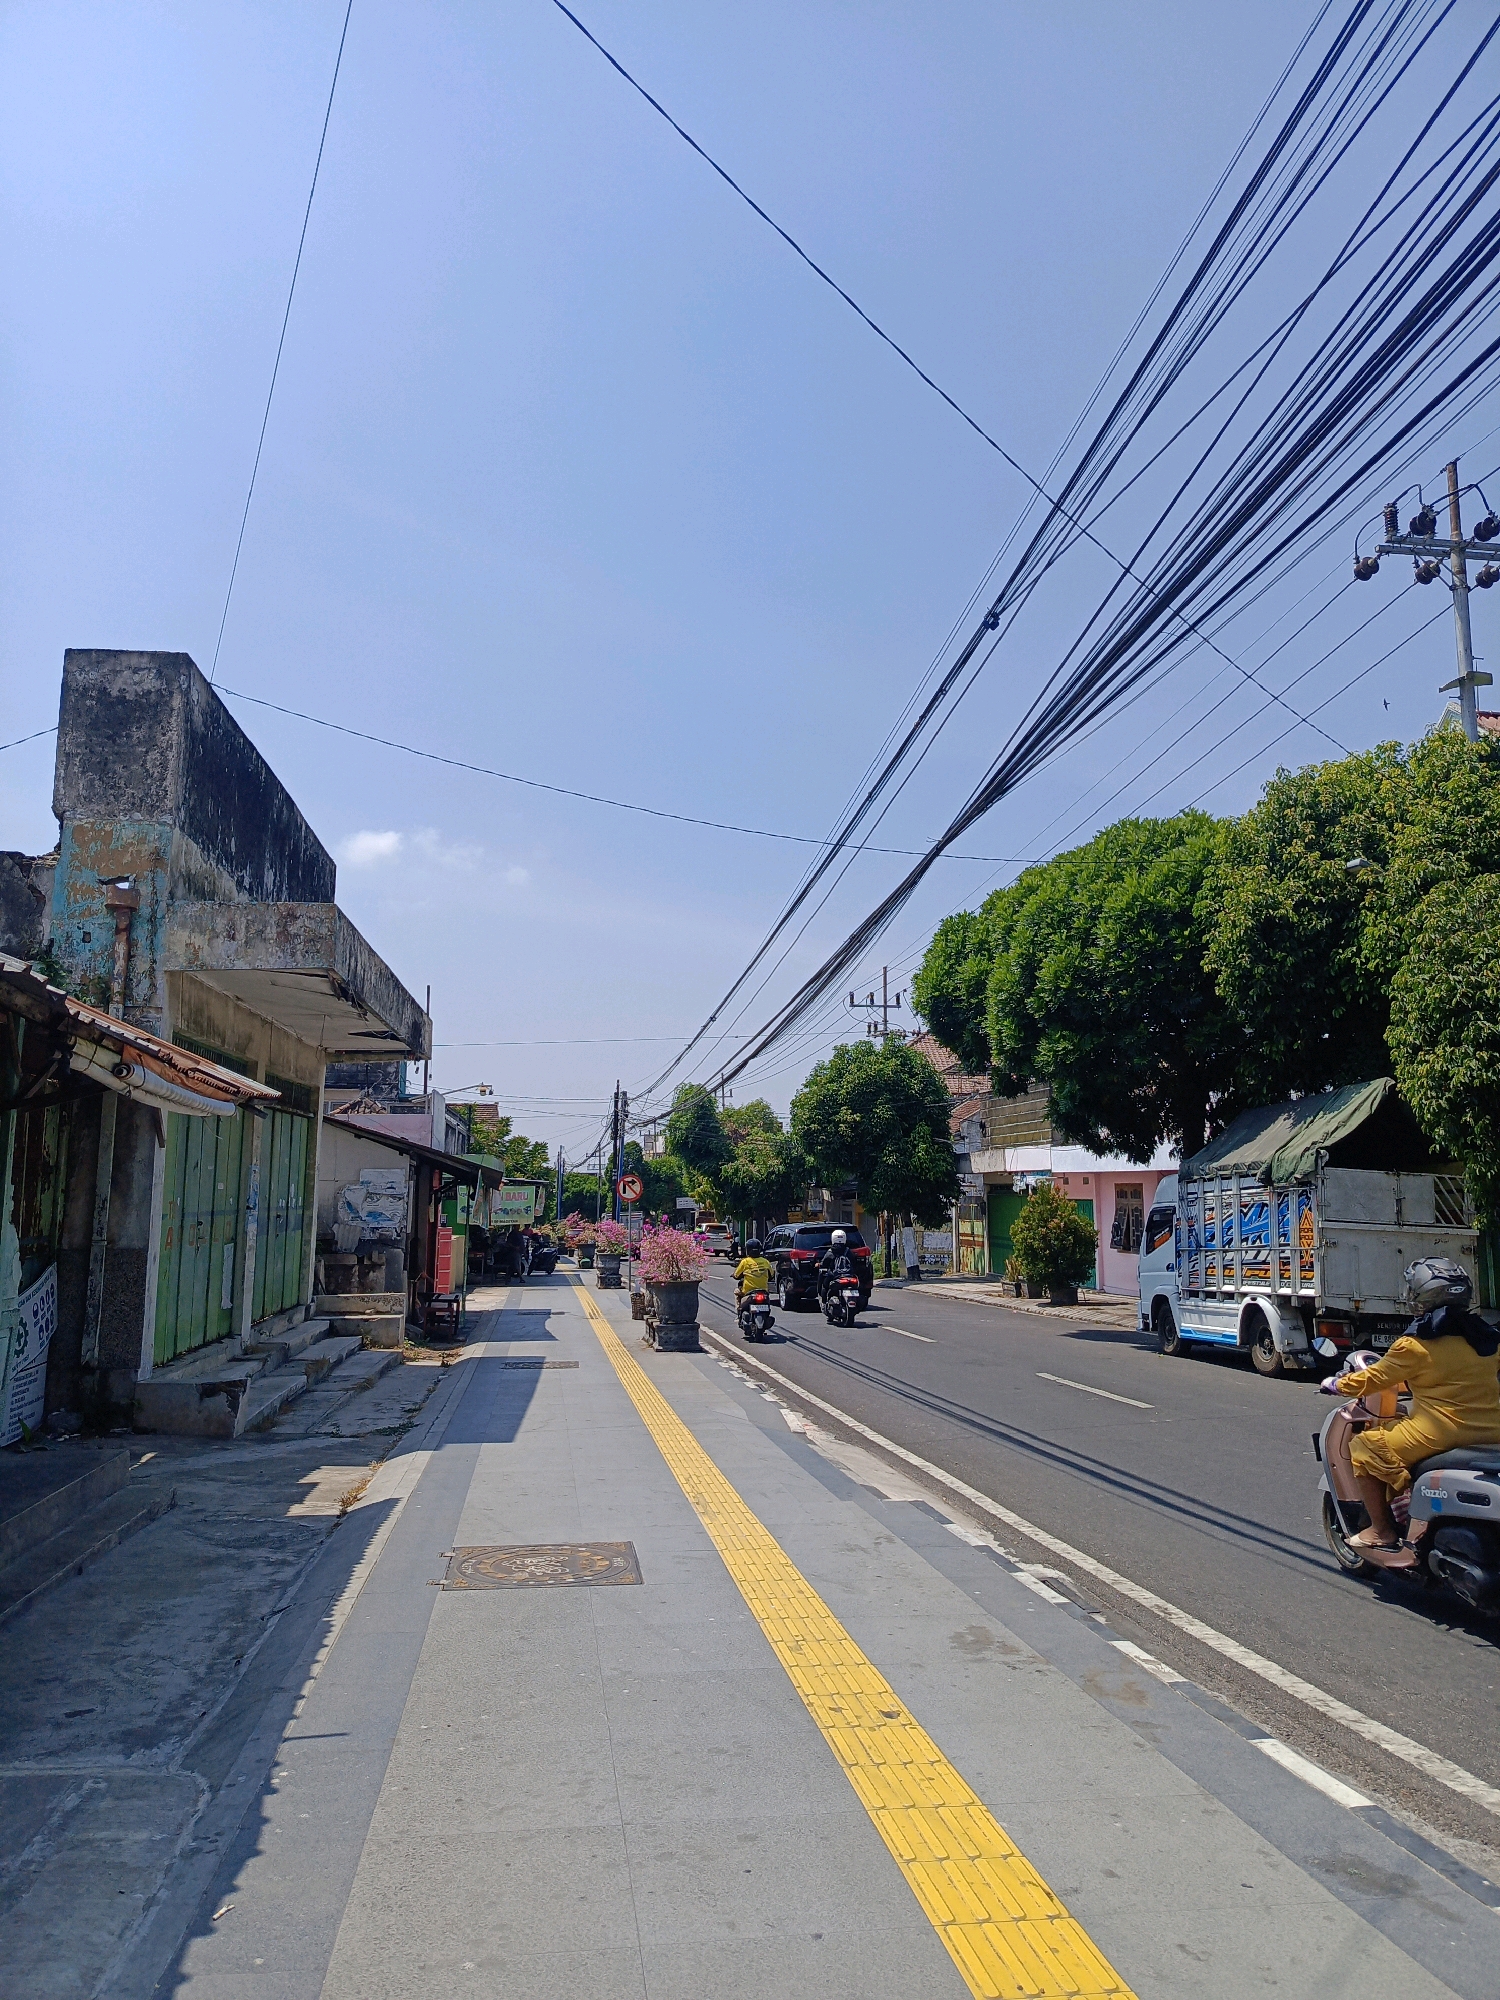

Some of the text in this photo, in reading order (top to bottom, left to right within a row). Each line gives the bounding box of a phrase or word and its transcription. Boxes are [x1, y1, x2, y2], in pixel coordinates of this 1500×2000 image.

[505, 1192, 528, 1201] BARU
[1376, 1322, 1401, 1330] SENSOR
[1420, 1485, 1448, 1499] Fazzio
